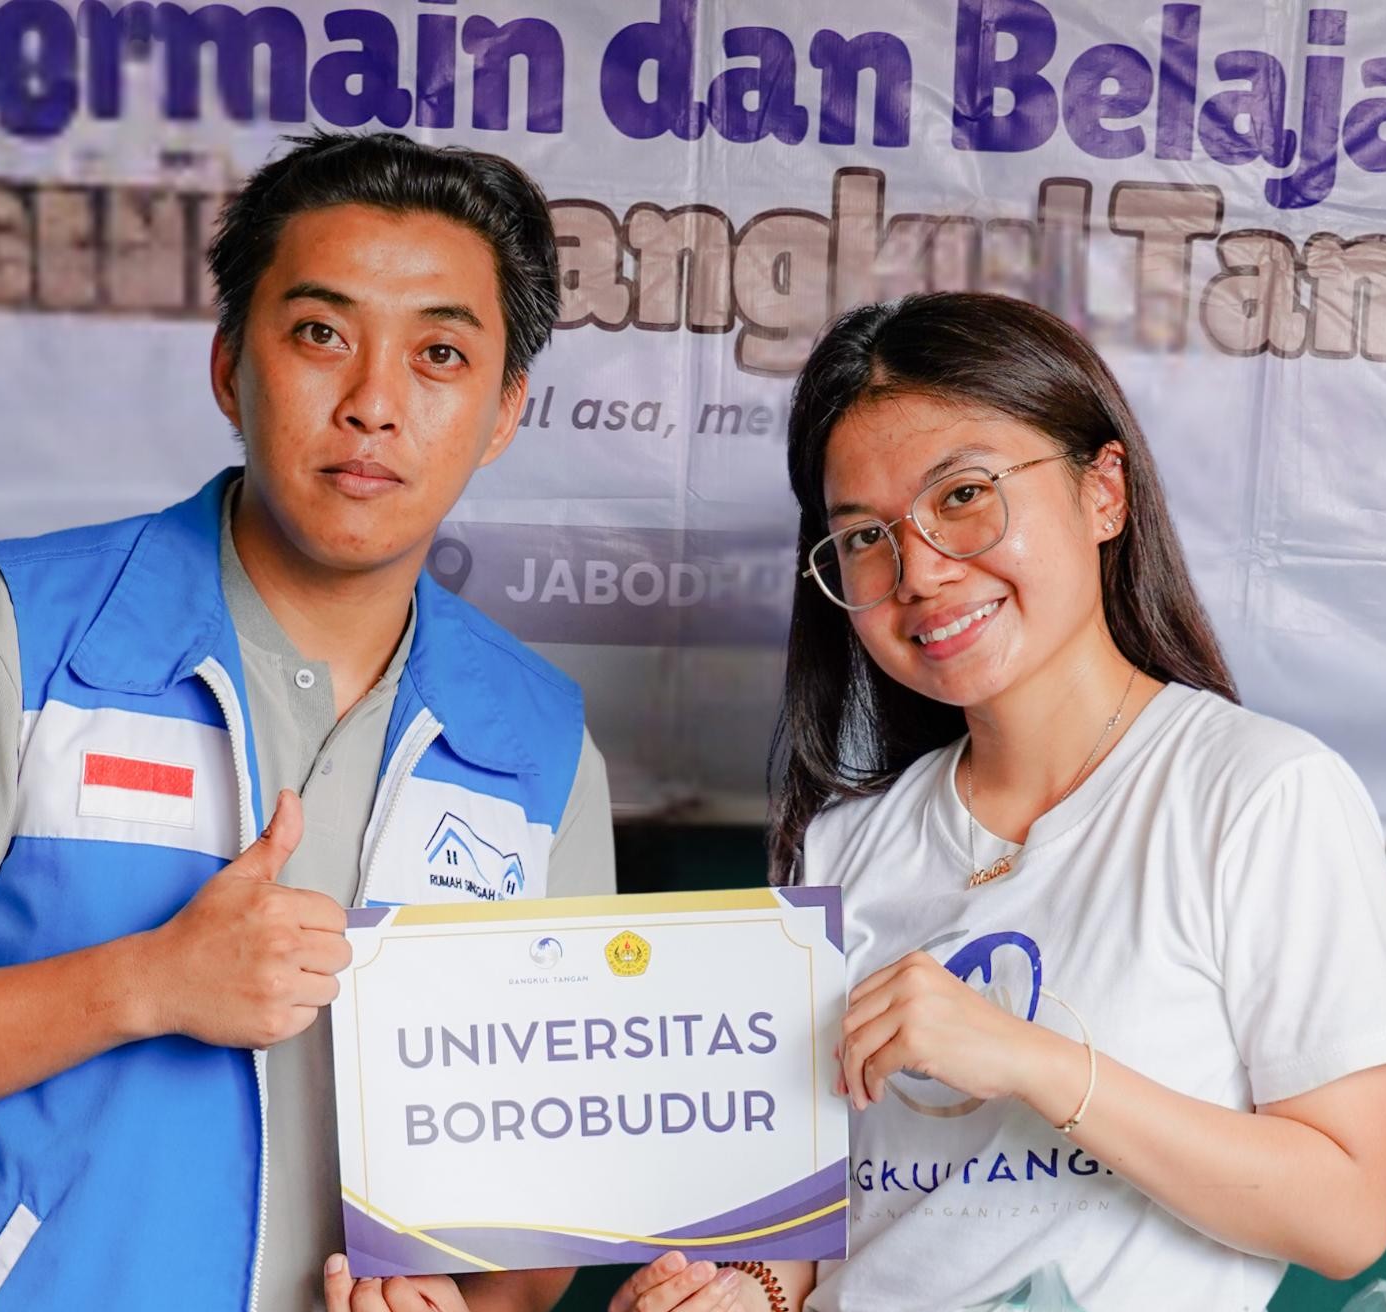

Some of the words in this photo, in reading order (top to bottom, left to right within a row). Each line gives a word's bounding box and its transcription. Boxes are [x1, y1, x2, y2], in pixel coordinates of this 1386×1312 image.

[599, 0, 912, 148] dan
[571, 398, 677, 439] asa,
[430, 874, 463, 890] RUMAH
[396, 1011, 777, 1069] UNIVERSITAS
[404, 1089, 776, 1146] BOROBUDUR
